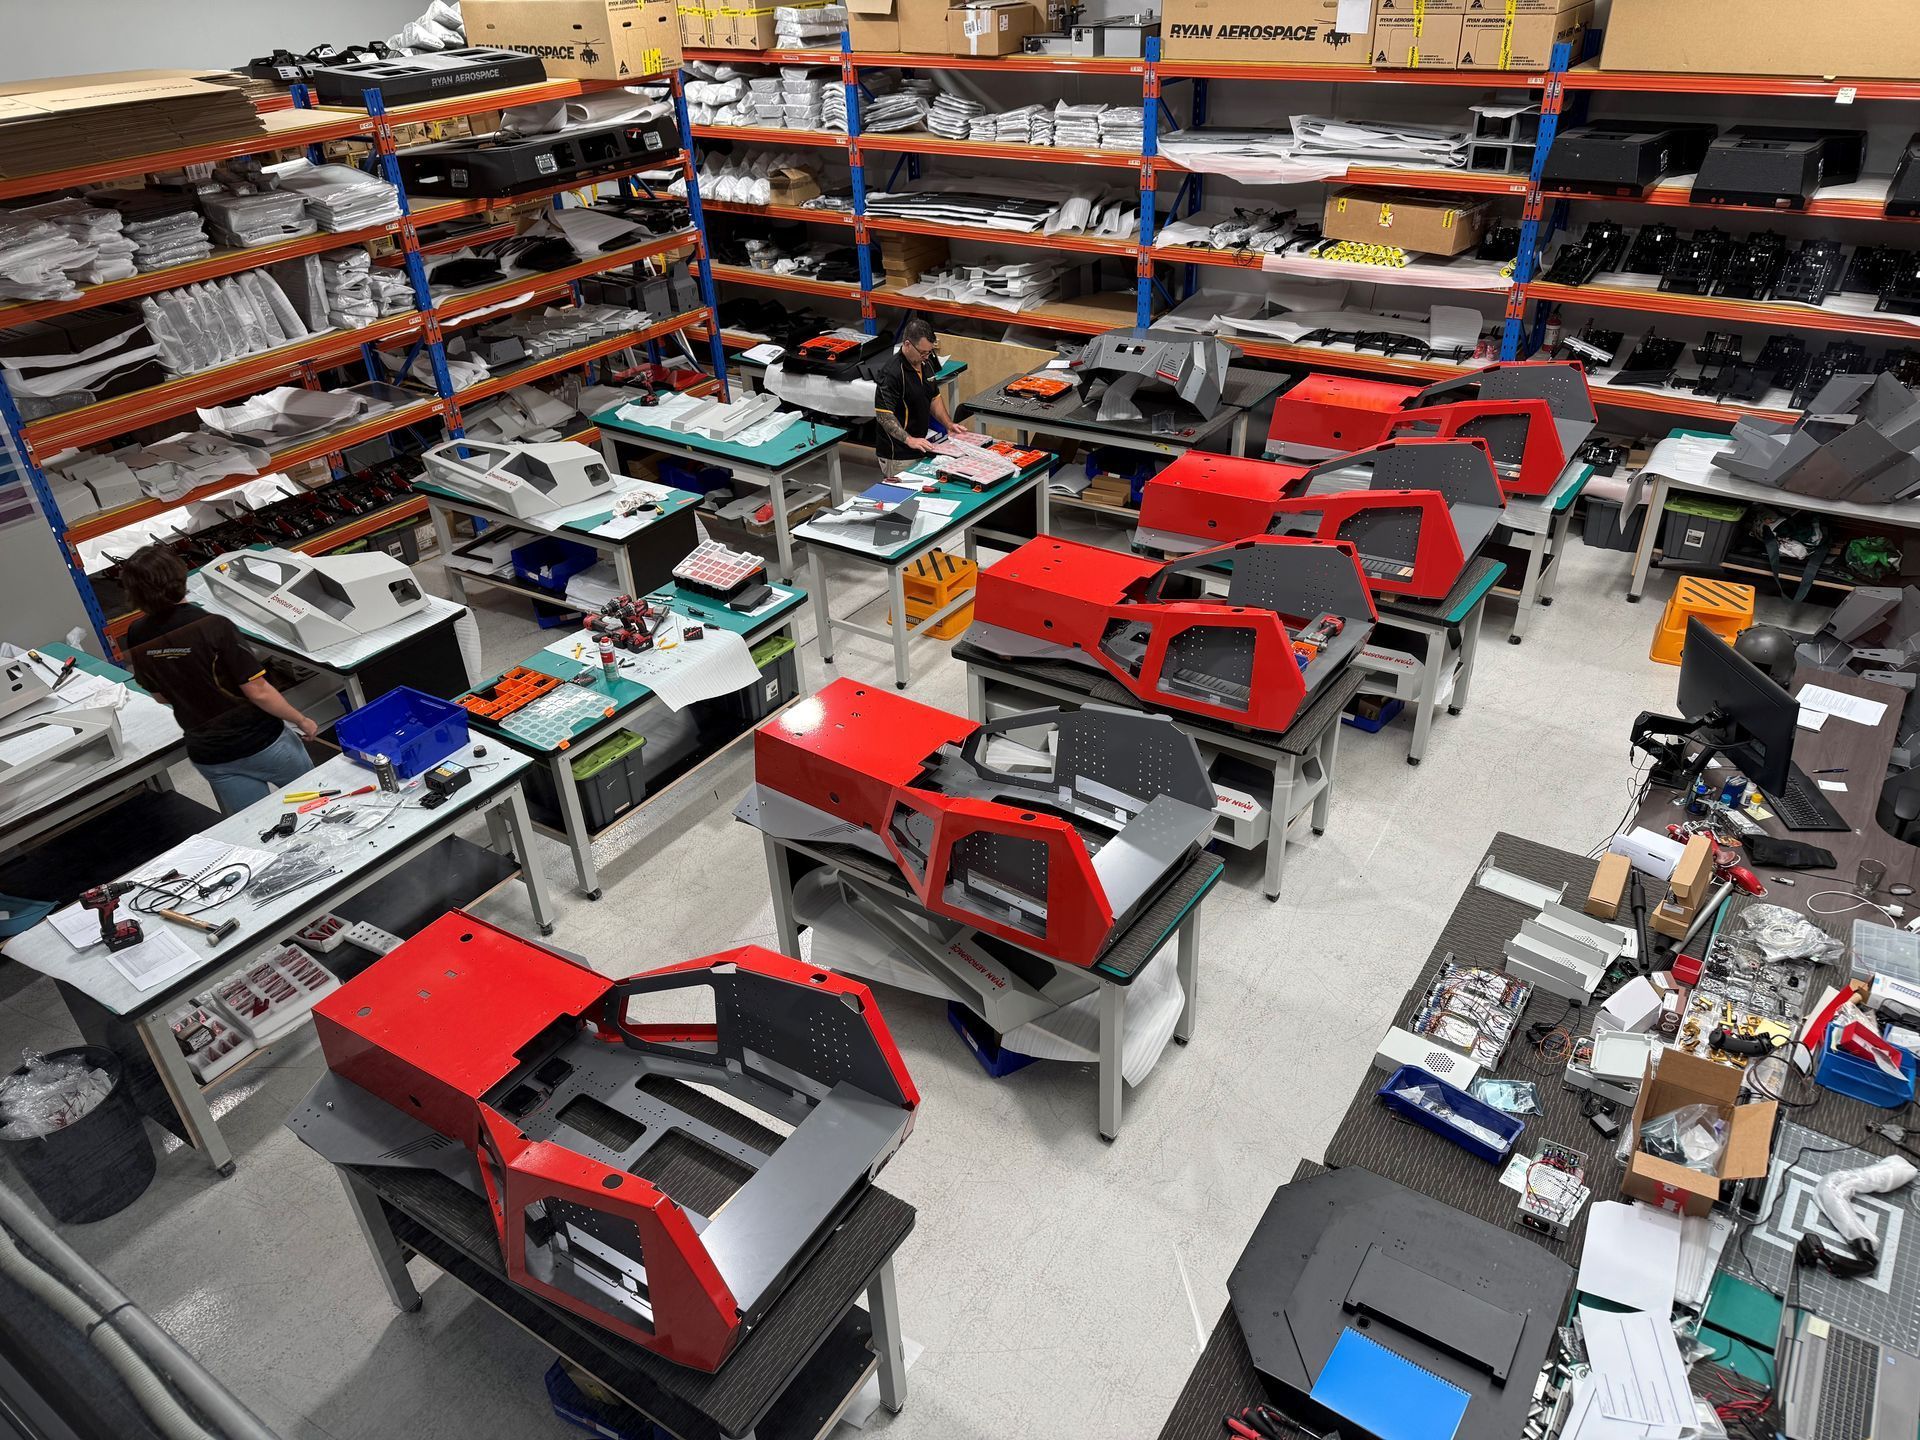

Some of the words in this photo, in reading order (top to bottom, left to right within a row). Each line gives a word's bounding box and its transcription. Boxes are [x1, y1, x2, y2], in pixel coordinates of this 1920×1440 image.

[1169, 23, 1214, 39] RYAN
[1215, 24, 1318, 41] AEROSPACE
[431, 74, 453, 87] RYAN
[455, 68, 500, 83] AEROSPACE
[1231, 799, 1254, 811] RYAN
[949, 943, 989, 974] AEROSPACE
[985, 972, 1006, 989] RYAN
